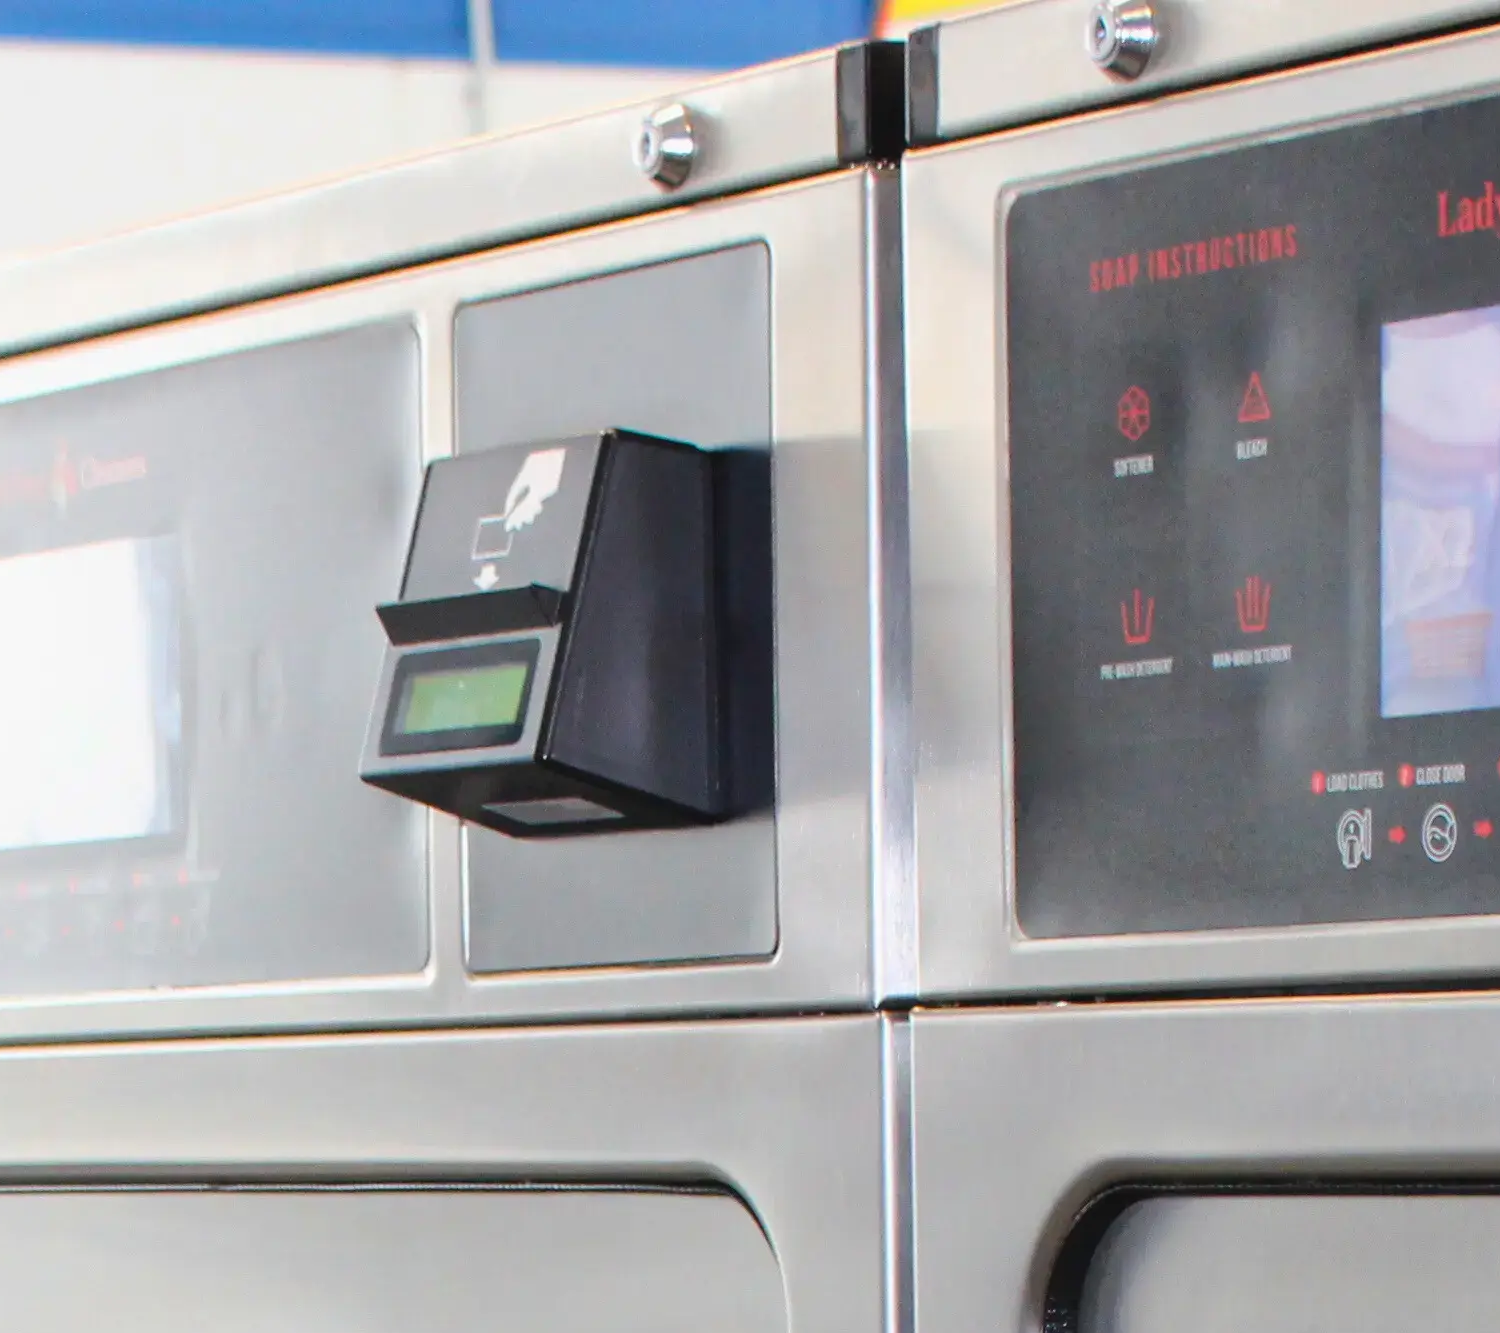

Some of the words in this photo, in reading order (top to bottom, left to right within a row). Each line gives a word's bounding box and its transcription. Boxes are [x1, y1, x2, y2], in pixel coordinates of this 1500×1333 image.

[1089, 253, 1139, 293] SOAP
[1148, 223, 1298, 284] INSTRUCTIONS
[1236, 438, 1268, 460] BLEACH
[1326, 773, 1348, 794] LOAD
[1348, 770, 1385, 790] CLOTHES
[1416, 765, 1442, 787] CLOSE
[1442, 763, 1466, 784] DOOR
